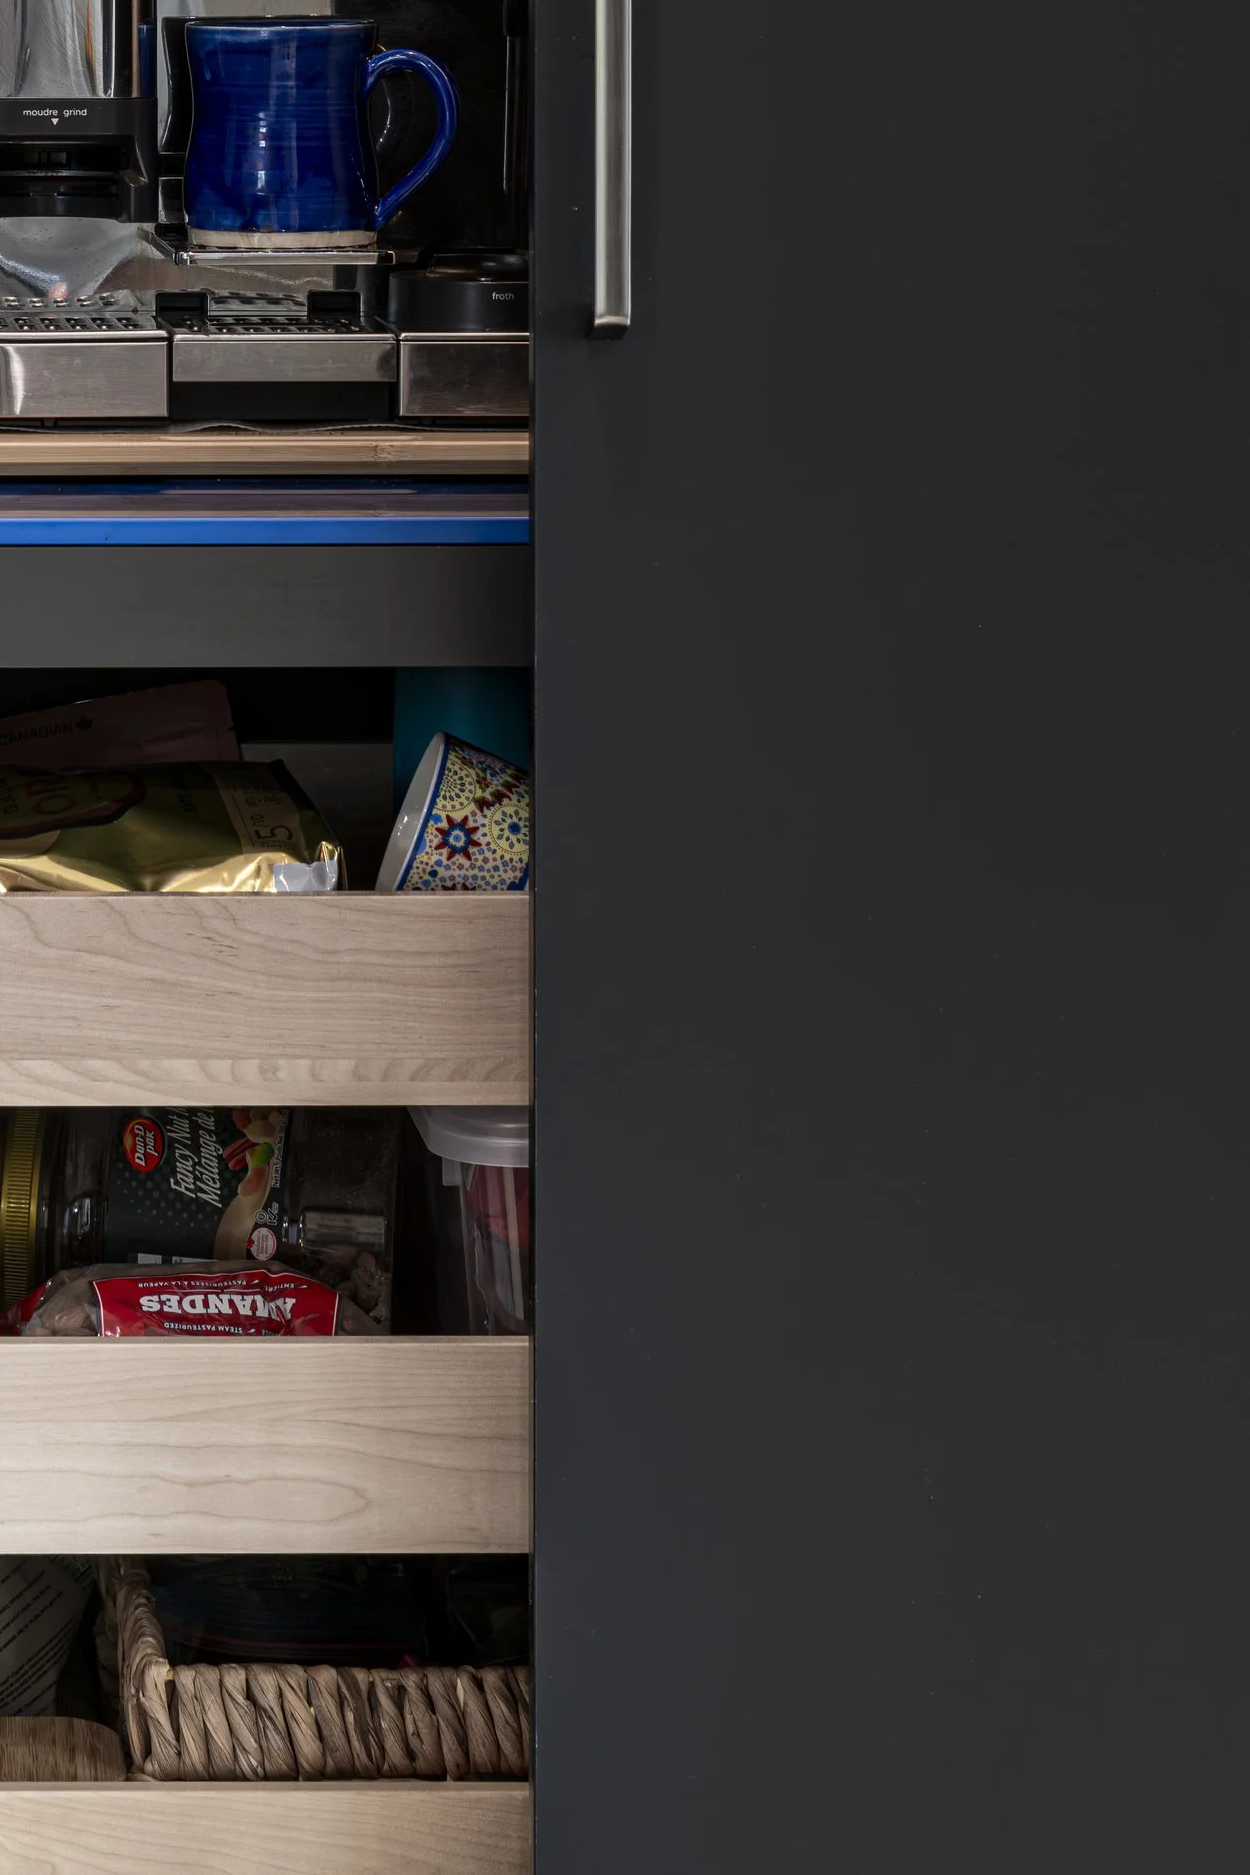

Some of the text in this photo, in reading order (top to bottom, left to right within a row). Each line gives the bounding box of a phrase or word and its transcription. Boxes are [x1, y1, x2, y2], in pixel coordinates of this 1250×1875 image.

[22, 108, 88, 117] moudre grind
[492, 291, 515, 300] froth
[135, 1125, 146, 1166] Dan-D
[146, 1130, 159, 1156] pak
[167, 1114, 198, 1198] Fancy Nut
[193, 1112, 223, 1208] Mélange de
[138, 1293, 297, 1321] AMANDES
[164, 1322, 243, 1334] STEAM PASTEURIZED
